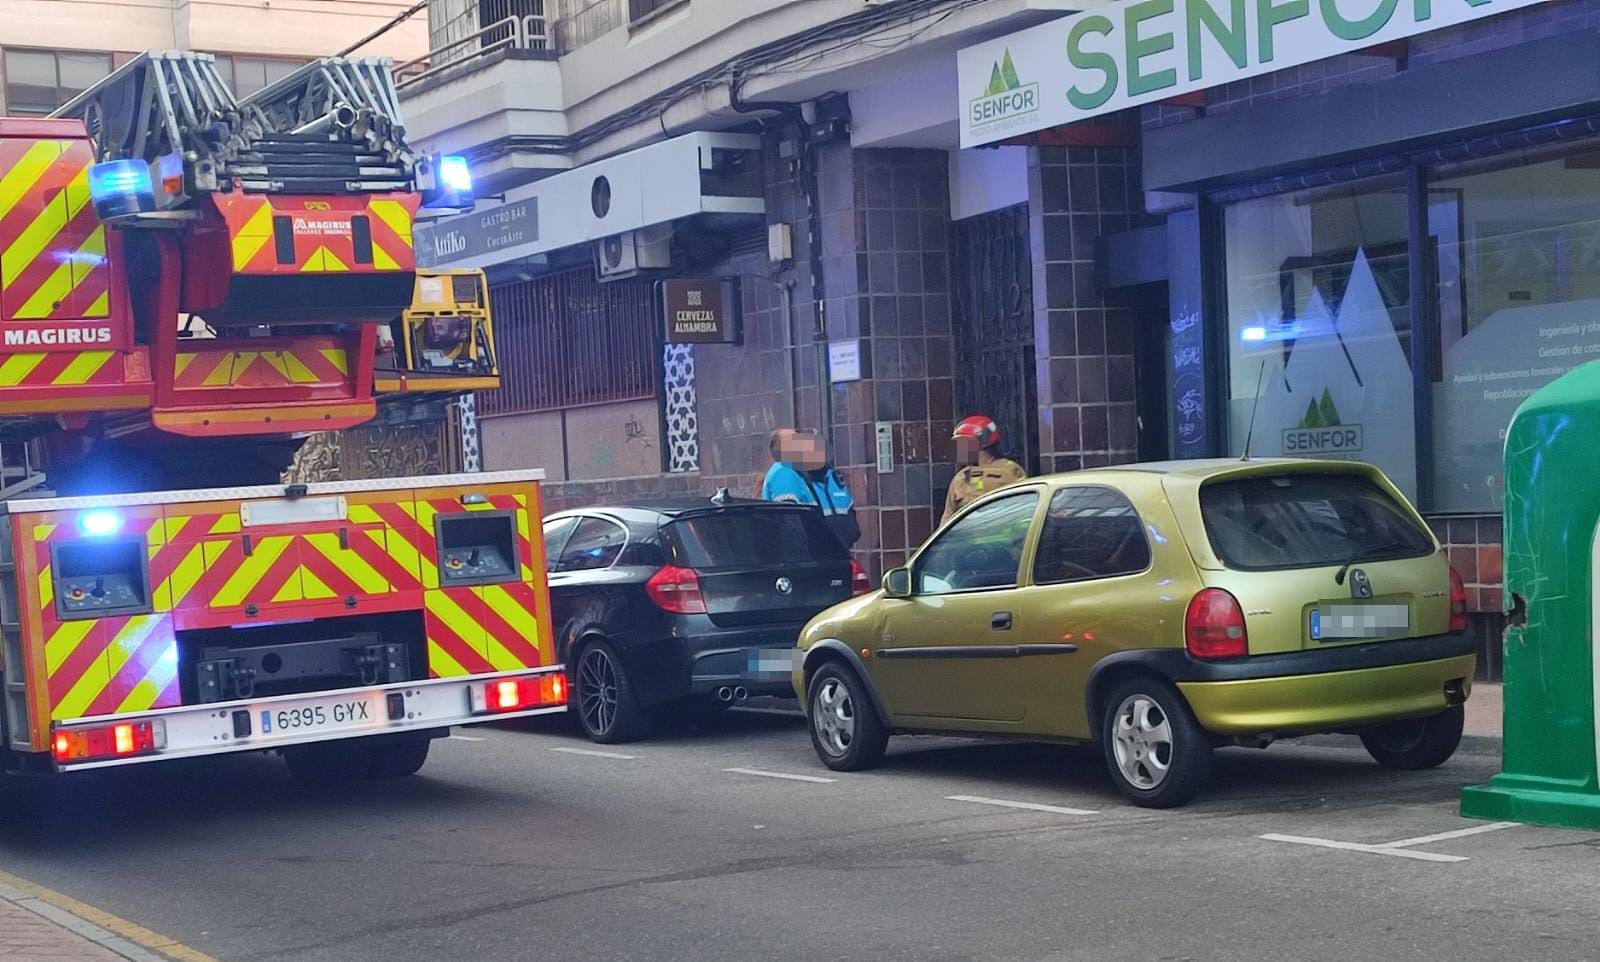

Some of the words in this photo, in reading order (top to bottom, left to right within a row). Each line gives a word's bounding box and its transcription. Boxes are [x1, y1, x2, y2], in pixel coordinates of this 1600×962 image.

[973, 90, 1034, 122] SENFOR
[308, 221, 352, 230] MAGIRUS
[481, 210, 511, 229] GASTRO
[511, 206, 527, 220] BAR
[486, 231, 523, 248] CocinArte
[676, 310, 715, 321] CERVEZAS
[675, 321, 718, 333] ALHAMBRA
[4, 327, 112, 346] MAGIRUS
[1538, 344, 1571, 358] Gestión
[1571, 343, 1583, 355] de
[1531, 367, 1565, 377] forestales
[1286, 430, 1357, 450] SENFOR
[277, 706, 326, 729] 6395
[333, 701, 369, 722] GYX
